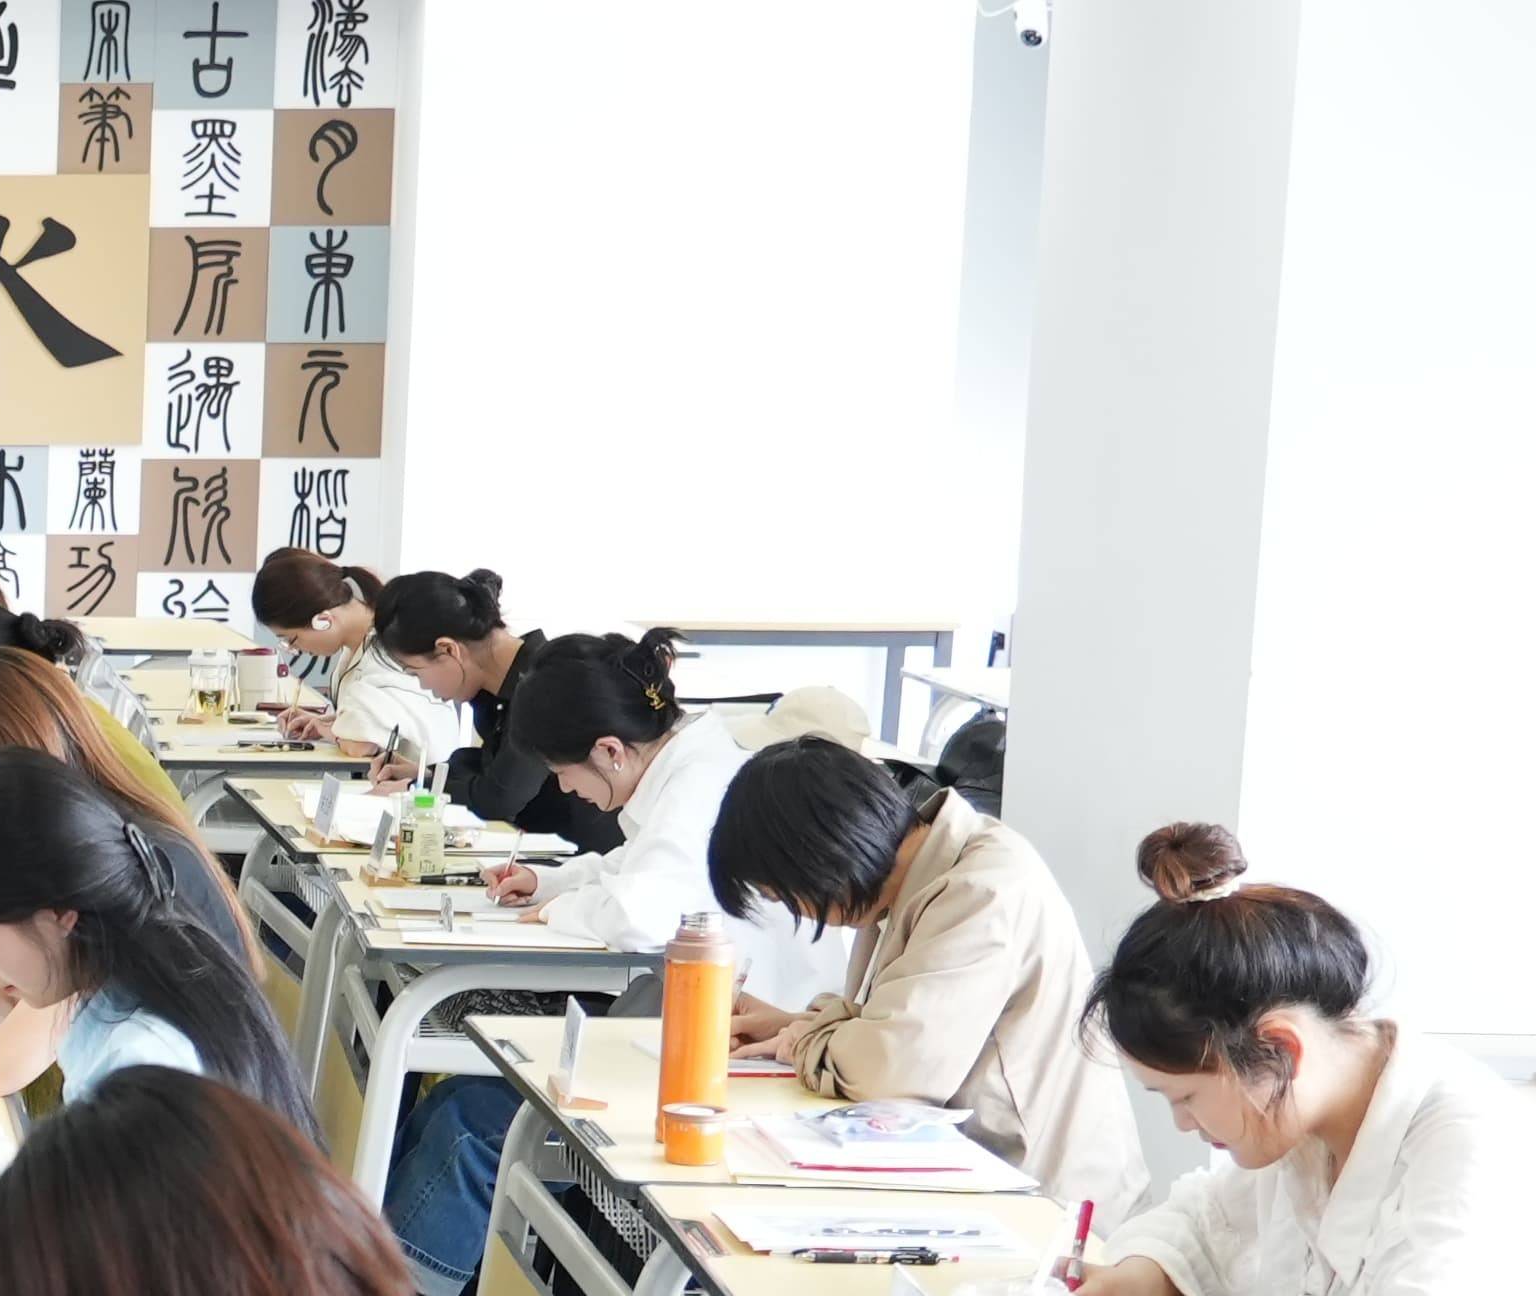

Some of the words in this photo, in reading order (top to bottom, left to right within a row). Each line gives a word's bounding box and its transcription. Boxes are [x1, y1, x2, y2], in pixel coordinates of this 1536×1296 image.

[83, 0, 131, 82] 宋
[182, 0, 249, 98] 古
[181, 118, 241, 218] 墨
[308, 119, 358, 217] 月
[303, 228, 354, 340] 東
[166, 349, 241, 453] 遇
[298, 349, 349, 453] 元
[68, 447, 118, 531] 蘭
[163, 466, 232, 566] 欣
[288, 467, 350, 562] 楷
[66, 541, 116, 617] 功
